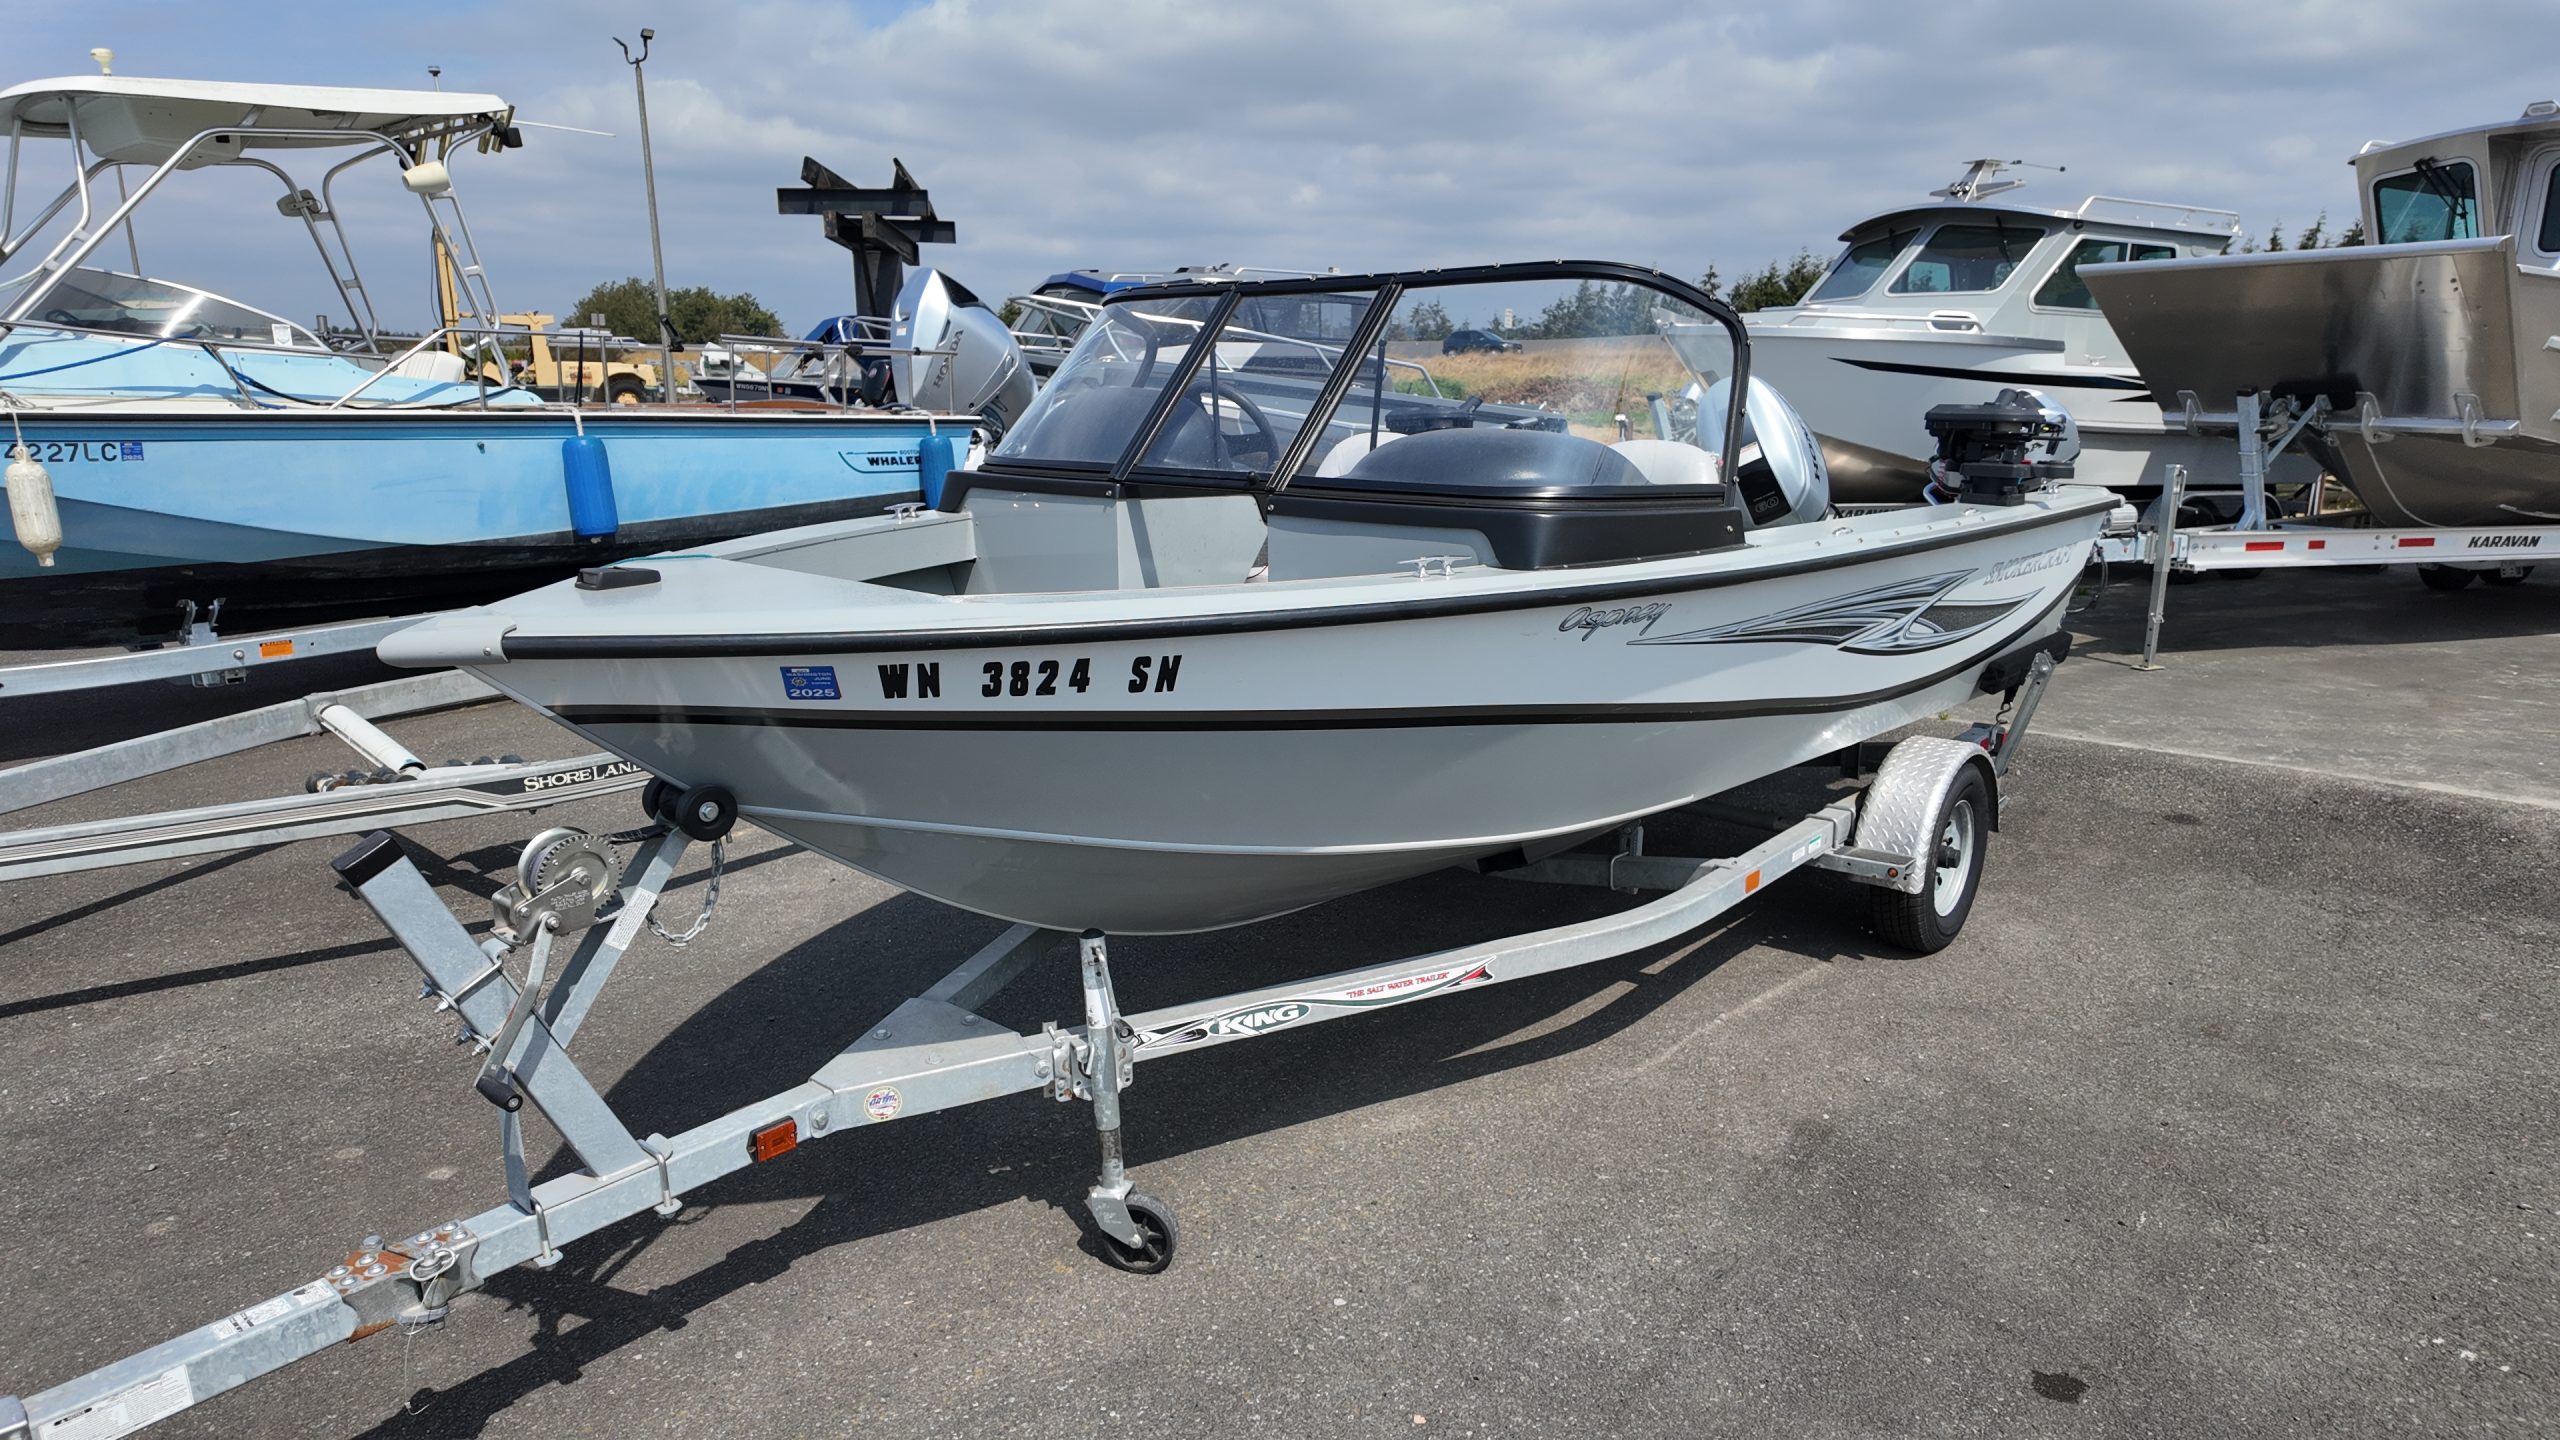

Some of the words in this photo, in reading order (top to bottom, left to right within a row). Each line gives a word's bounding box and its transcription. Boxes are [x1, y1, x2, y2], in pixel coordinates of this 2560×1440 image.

[2467, 535, 2542, 549] KARAVAN
[1559, 602, 1673, 642] Osprey
[877, 662, 941, 699] WN
[981, 657, 1091, 698] 3824
[1127, 654, 1183, 694] SN
[790, 688, 835, 697] 2025
[1366, 985, 1385, 995] SALT
[1387, 979, 1414, 990] WATER
[1218, 1004, 1300, 1036] KING
